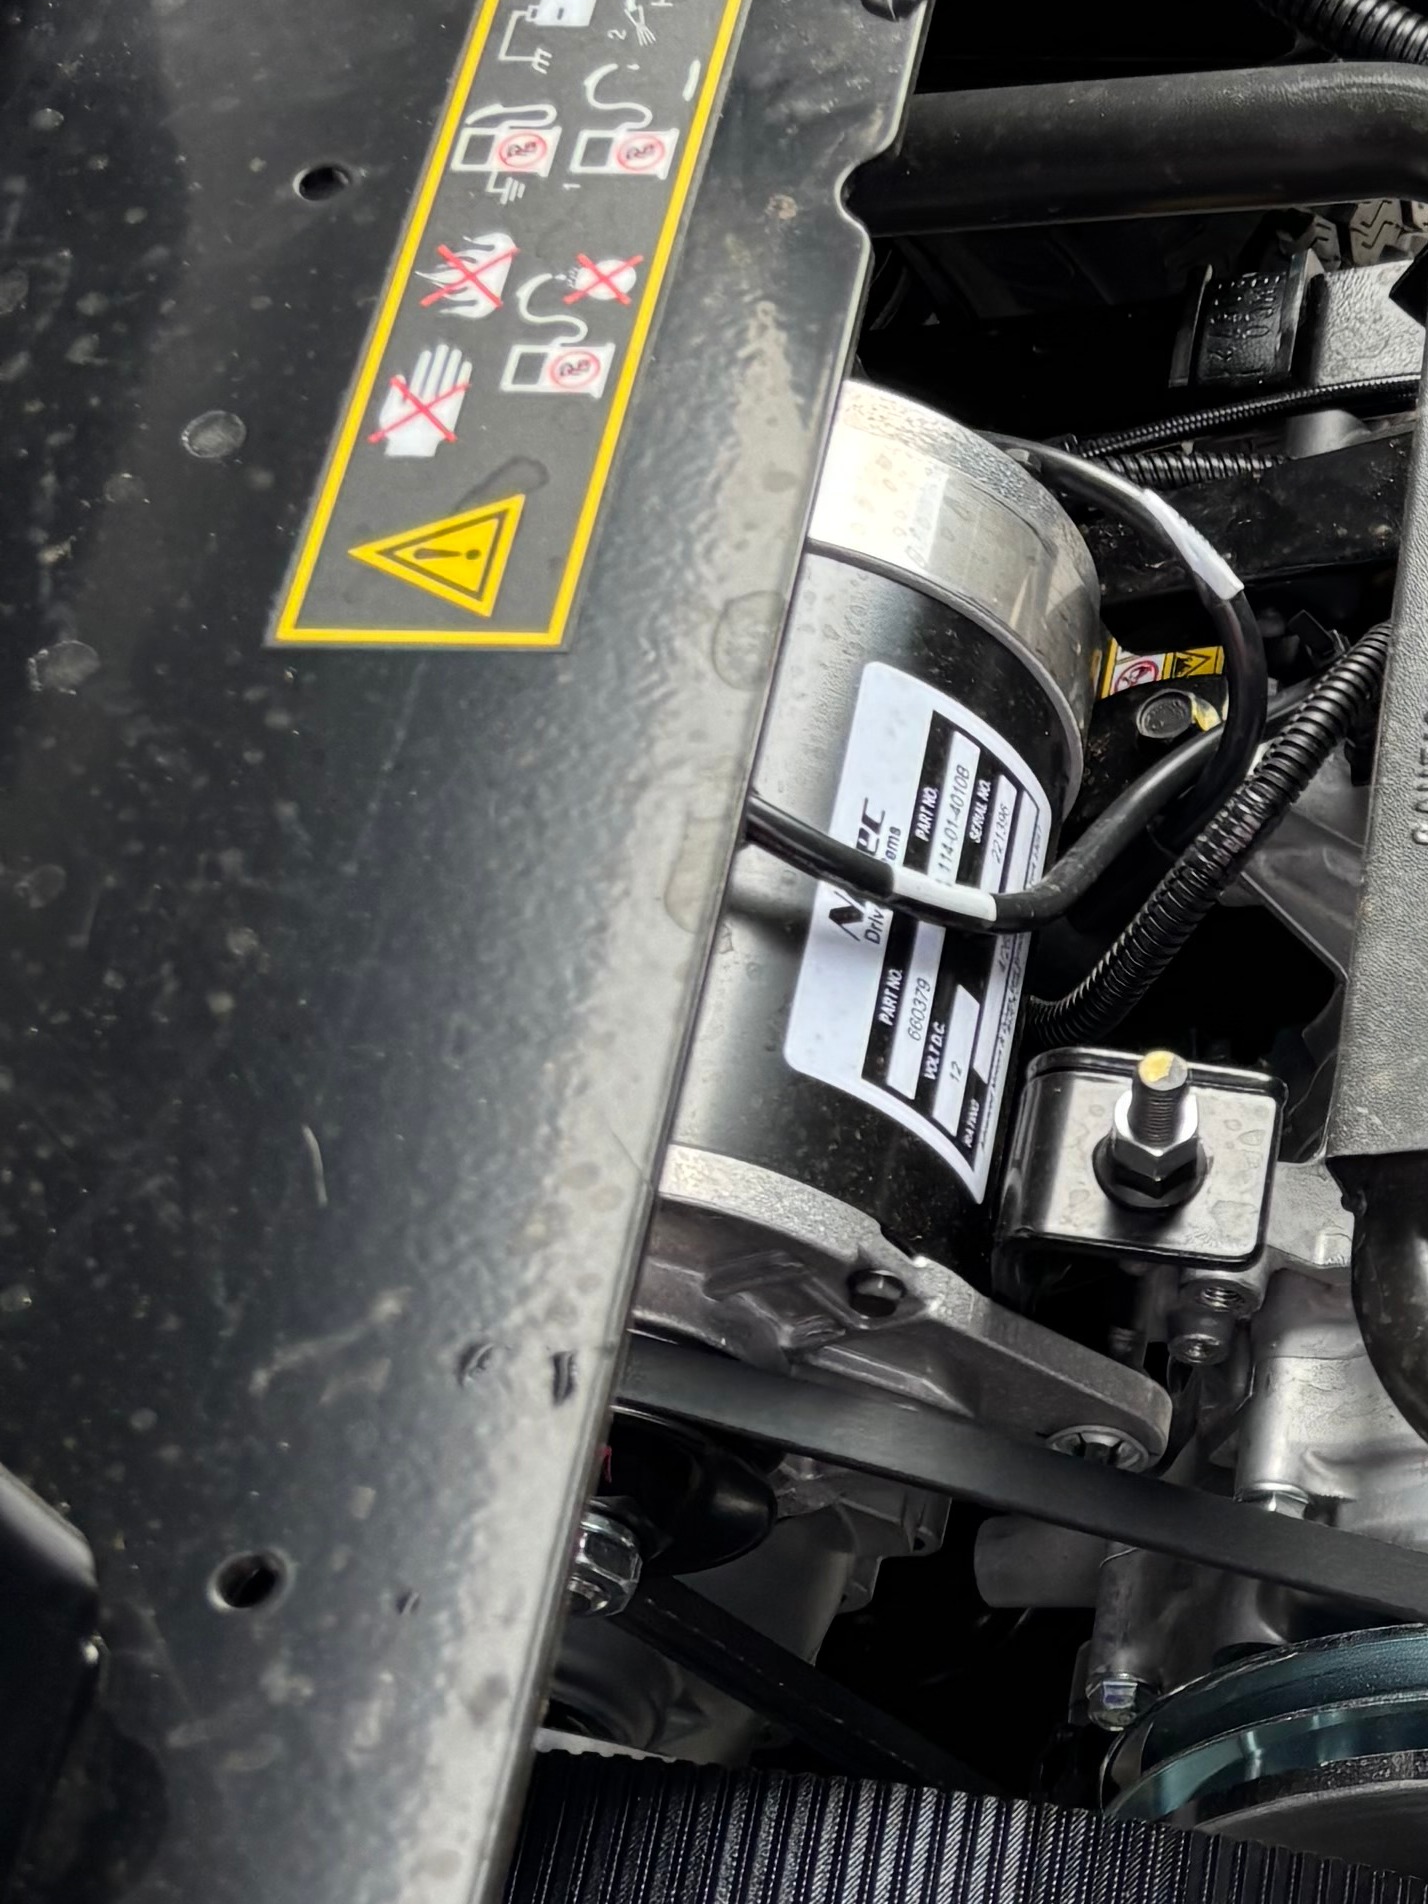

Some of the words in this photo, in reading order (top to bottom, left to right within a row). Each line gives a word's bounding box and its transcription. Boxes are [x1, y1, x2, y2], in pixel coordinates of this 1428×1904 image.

[920, 784, 939, 810] NO.
[914, 807, 935, 842] PART
[967, 800, 989, 844] SERIAL
[827, 796, 886, 941] Nec
[885, 965, 903, 991] NO.
[878, 988, 900, 1026] PART
[904, 975, 933, 1042] 660379
[922, 1045, 942, 1080] VOLT
[948, 1059, 964, 1083] 12
